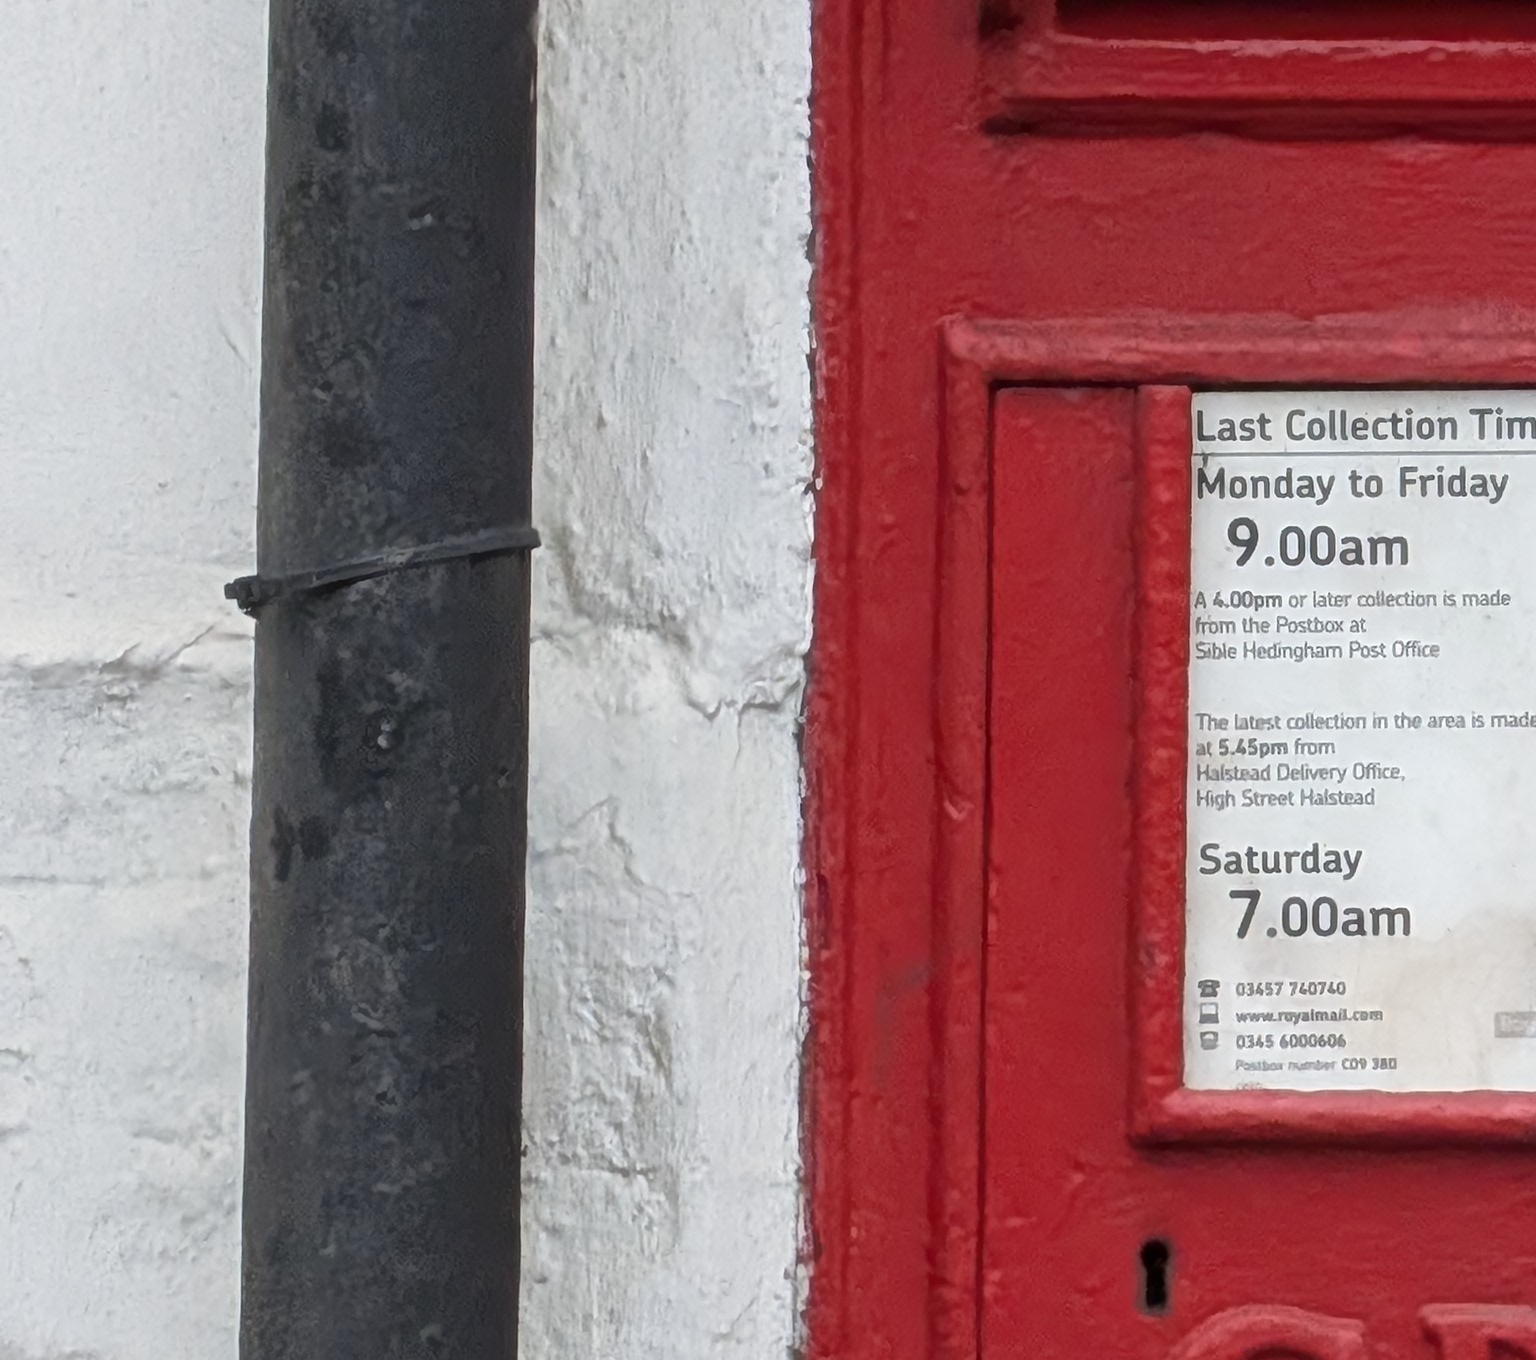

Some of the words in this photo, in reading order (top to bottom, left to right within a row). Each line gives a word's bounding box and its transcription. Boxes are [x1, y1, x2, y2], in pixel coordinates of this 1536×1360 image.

[1197, 409, 1272, 443] Last
[1285, 408, 1460, 441] Collection
[1197, 467, 1336, 506] Monday
[1347, 470, 1384, 499] to
[1399, 465, 1510, 505] Friday
[1226, 516, 1410, 567] 9.00am
[1194, 591, 1207, 609] A
[1212, 591, 1283, 611] 4.00pm
[1288, 595, 1308, 609] or
[1312, 591, 1353, 608] later
[1357, 590, 1438, 607] collection
[1442, 589, 1457, 607] is
[1462, 589, 1512, 606] made
[1195, 617, 1237, 635] from
[1241, 617, 1271, 634] the
[1276, 616, 1344, 633] Postbox
[1349, 618, 1367, 633] at
[1195, 641, 1238, 660] Sible
[1242, 641, 1343, 663] Hedingham
[1348, 640, 1387, 658] Post
[1391, 639, 1441, 658] Office
[1195, 713, 1229, 731] The
[1234, 714, 1282, 731] latest
[1286, 712, 1367, 730] collection
[1372, 712, 1389, 729] in
[1393, 712, 1423, 729] the
[1427, 715, 1466, 729] area
[1471, 711, 1486, 728] is
[1195, 741, 1214, 757] at
[1218, 738, 1289, 759] 5.45pm
[1294, 738, 1336, 755] from
[1196, 763, 1271, 782] Halstead
[1276, 762, 1348, 783] Delivery
[1352, 762, 1406, 782] Office,
[1196, 788, 1236, 811] High
[1240, 789, 1295, 808] Street
[1300, 788, 1376, 807] Halstead
[1198, 842, 1363, 881] Saturday
[1228, 889, 1412, 940] 7.00am
[1235, 981, 1284, 997] 03457
[1288, 981, 1347, 997] 740740
[1235, 1007, 1384, 1027] www.royalmail.com
[1235, 1033, 1275, 1050] 0345
